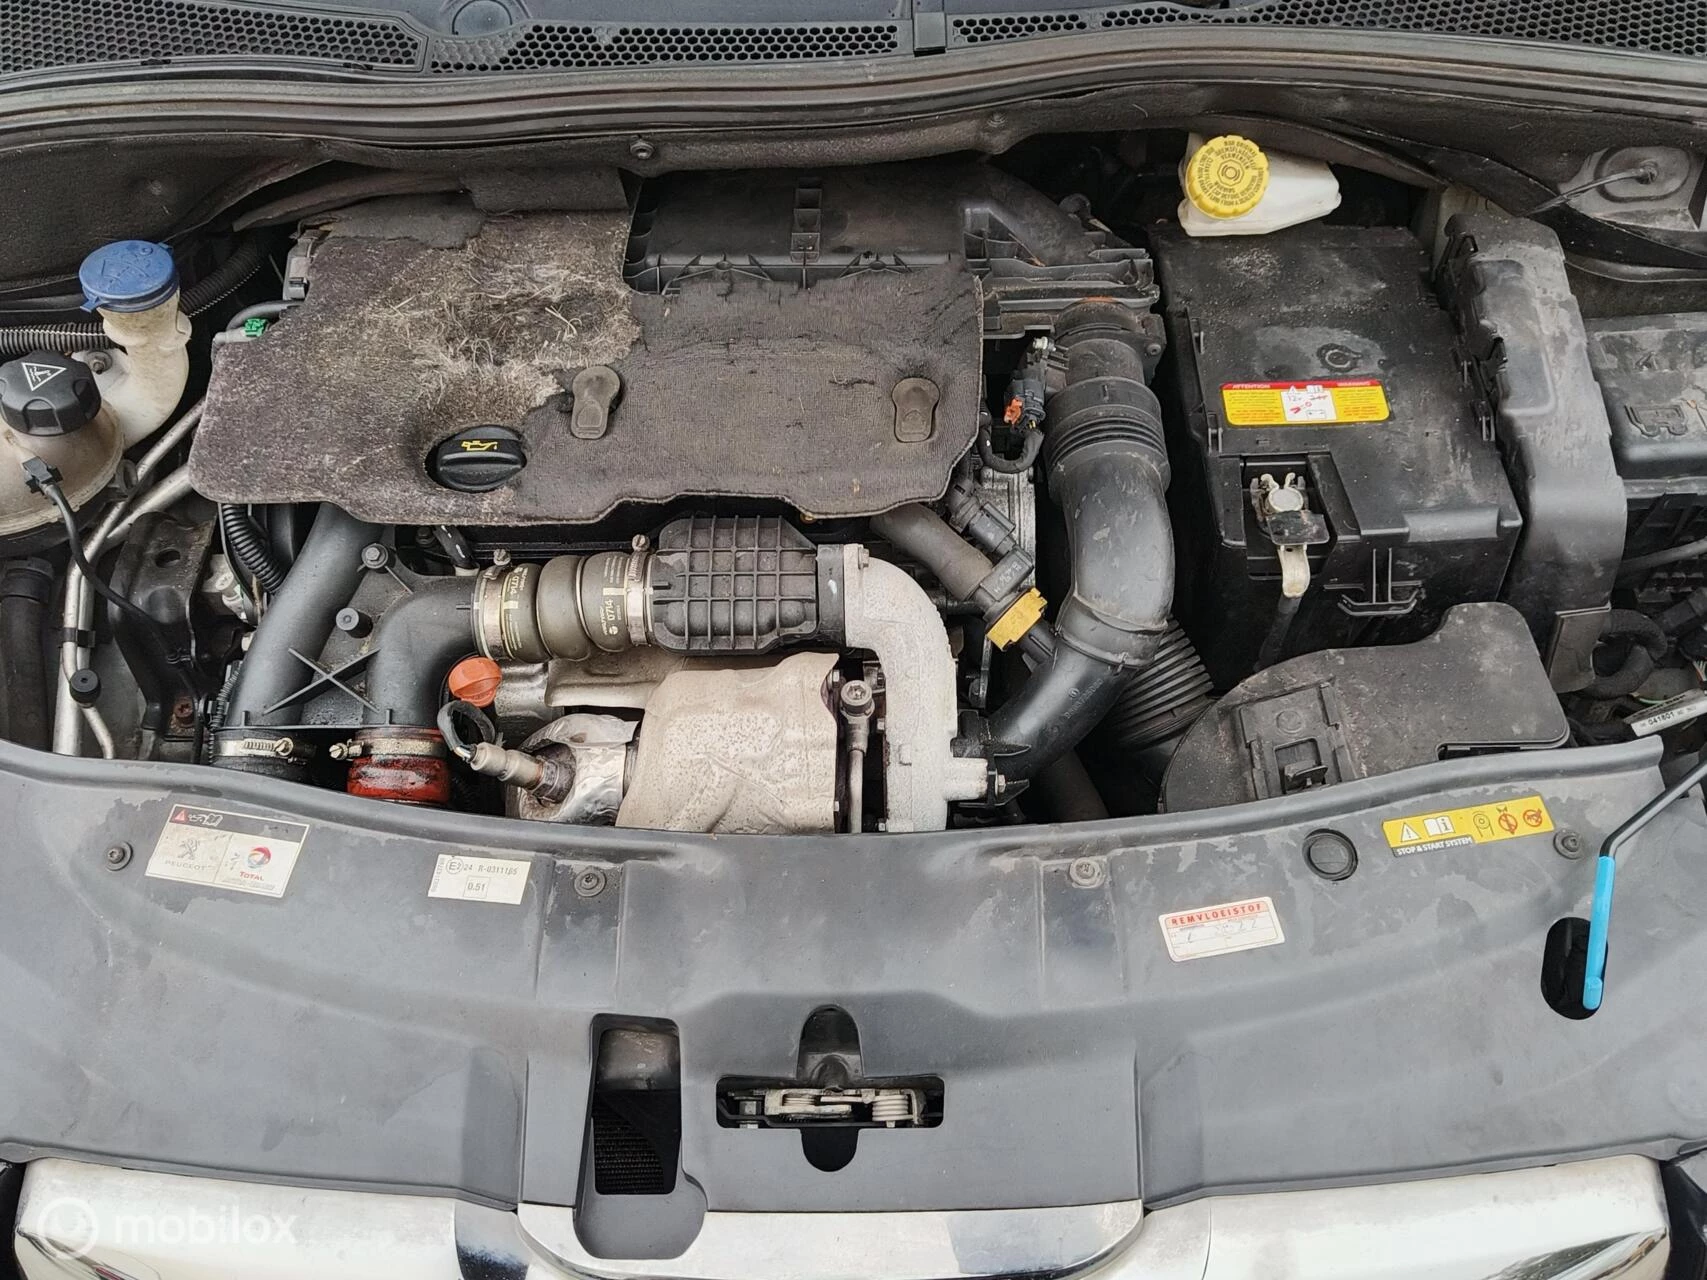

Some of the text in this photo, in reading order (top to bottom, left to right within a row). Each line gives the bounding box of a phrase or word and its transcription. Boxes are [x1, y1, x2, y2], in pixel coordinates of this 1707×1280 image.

[1397, 847, 1415, 856] STOP
[1422, 842, 1444, 852] START
[1445, 837, 1473, 848] SYSTEM
[239, 871, 265, 881] TOTAL
[467, 882, 486, 891] 0.51
